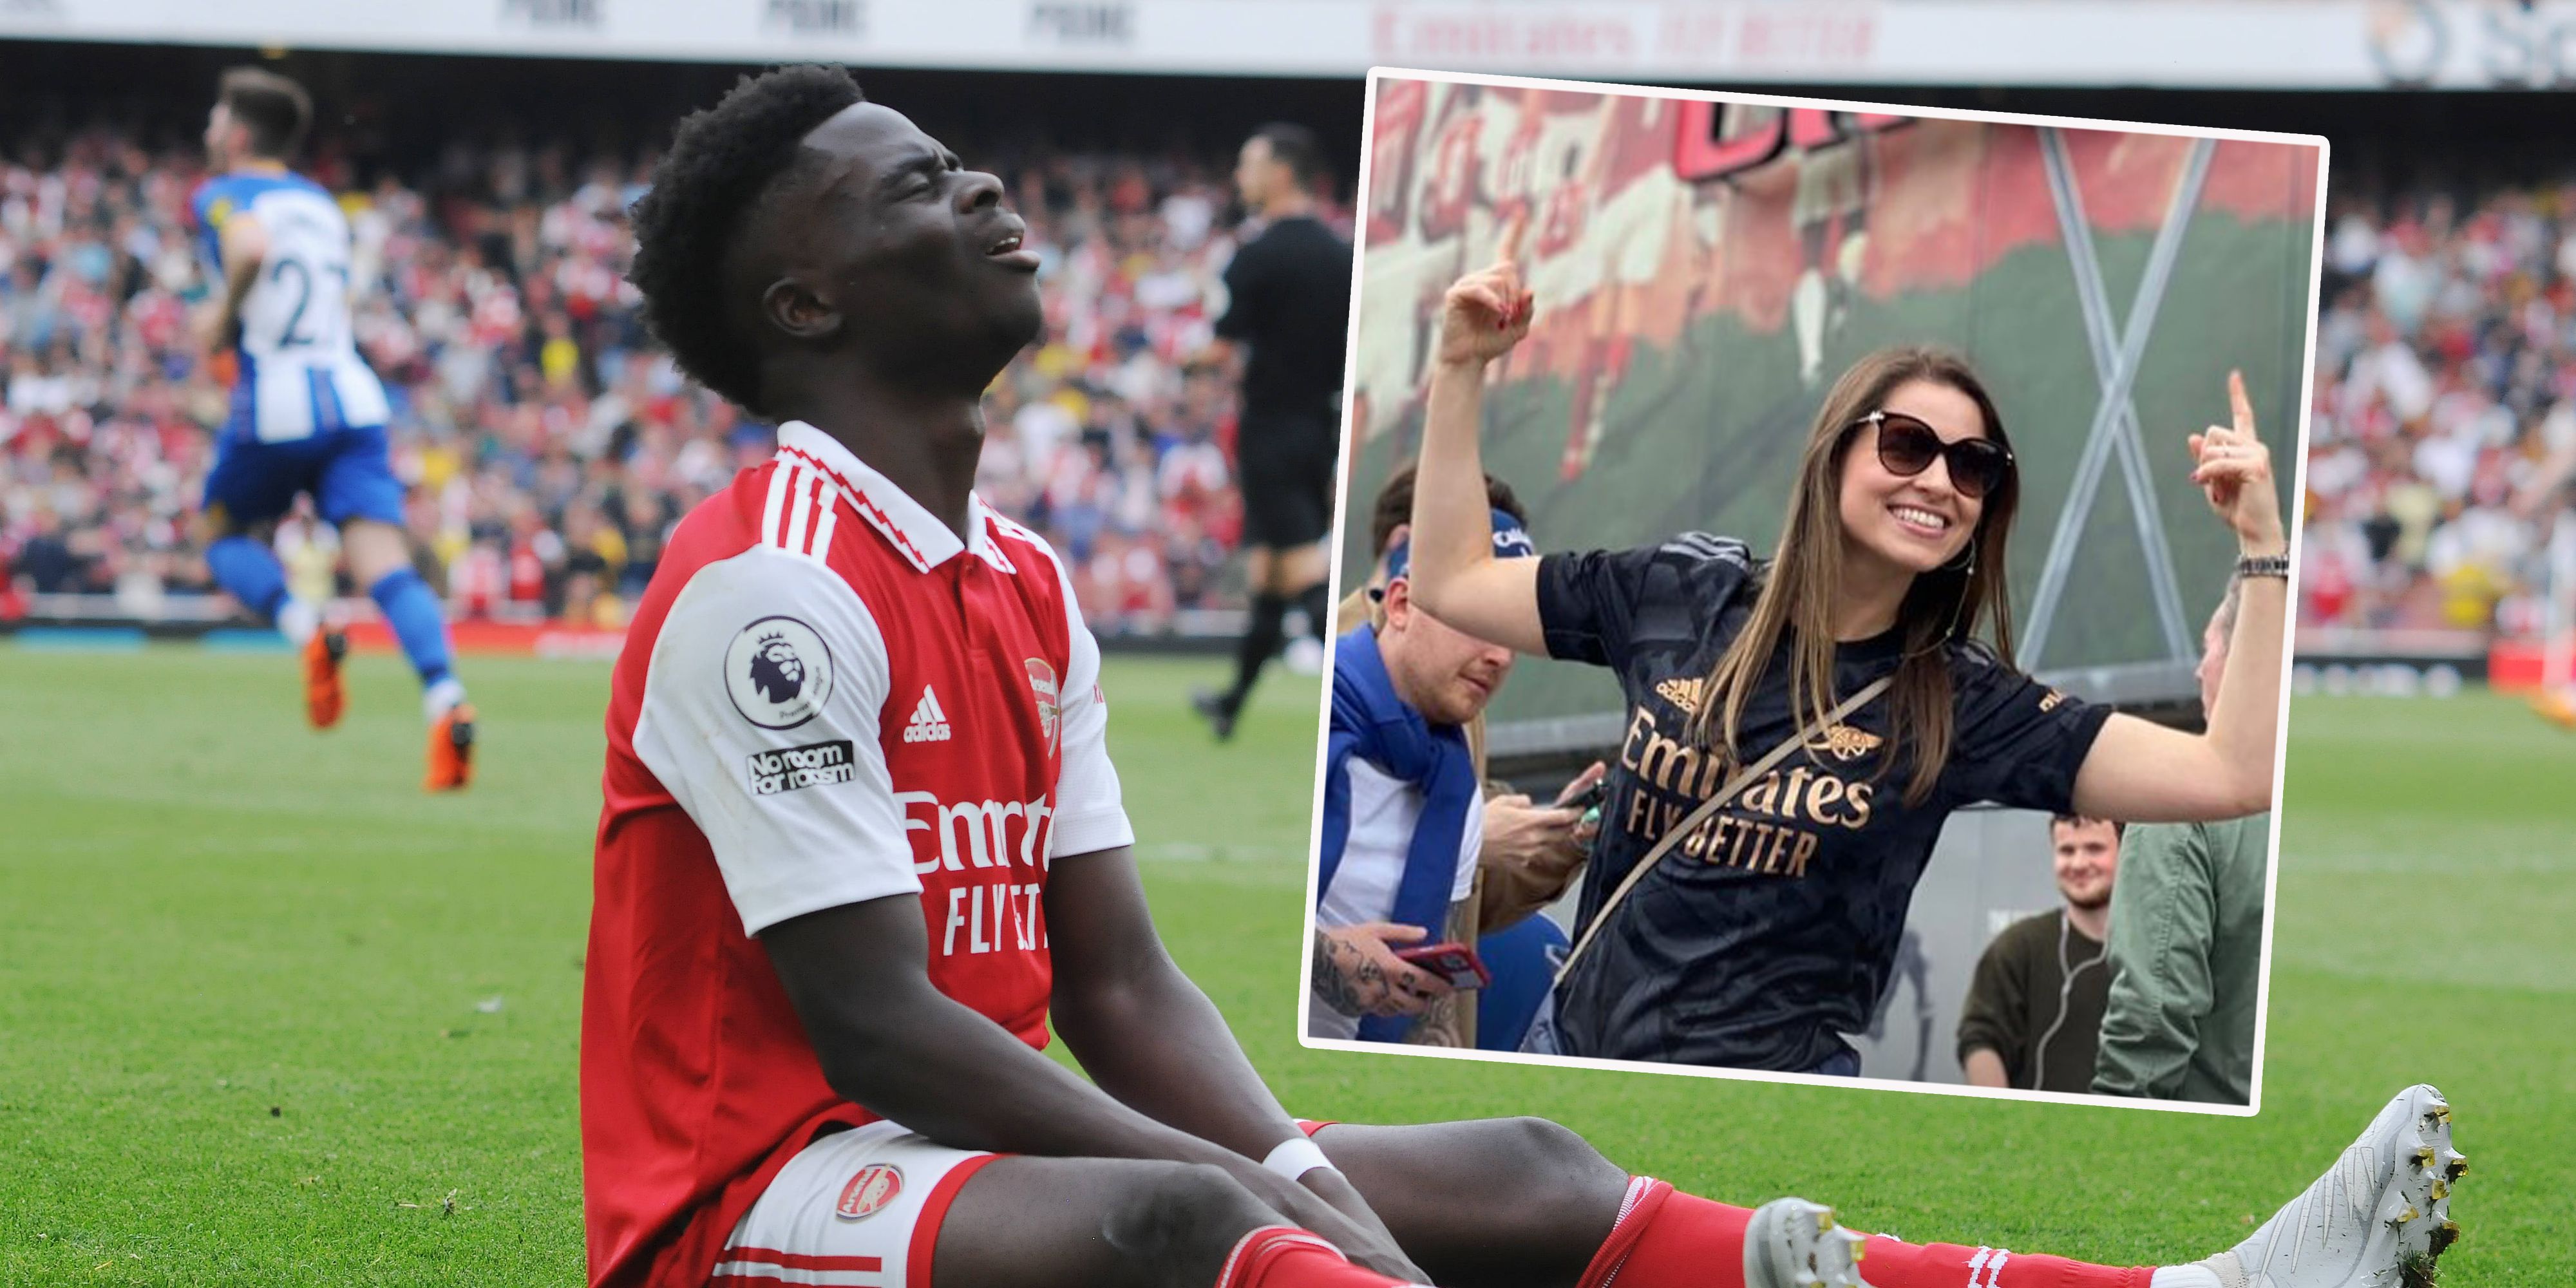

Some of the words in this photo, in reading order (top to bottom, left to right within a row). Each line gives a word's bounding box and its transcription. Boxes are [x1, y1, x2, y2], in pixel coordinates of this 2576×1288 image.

[904, 723, 951, 743] adidas
[748, 752, 783, 776] No
[781, 744, 844, 772] room
[1626, 788, 1683, 840] FLY
[1684, 815, 1820, 878] BETTER
[943, 883, 1007, 956] FLY
